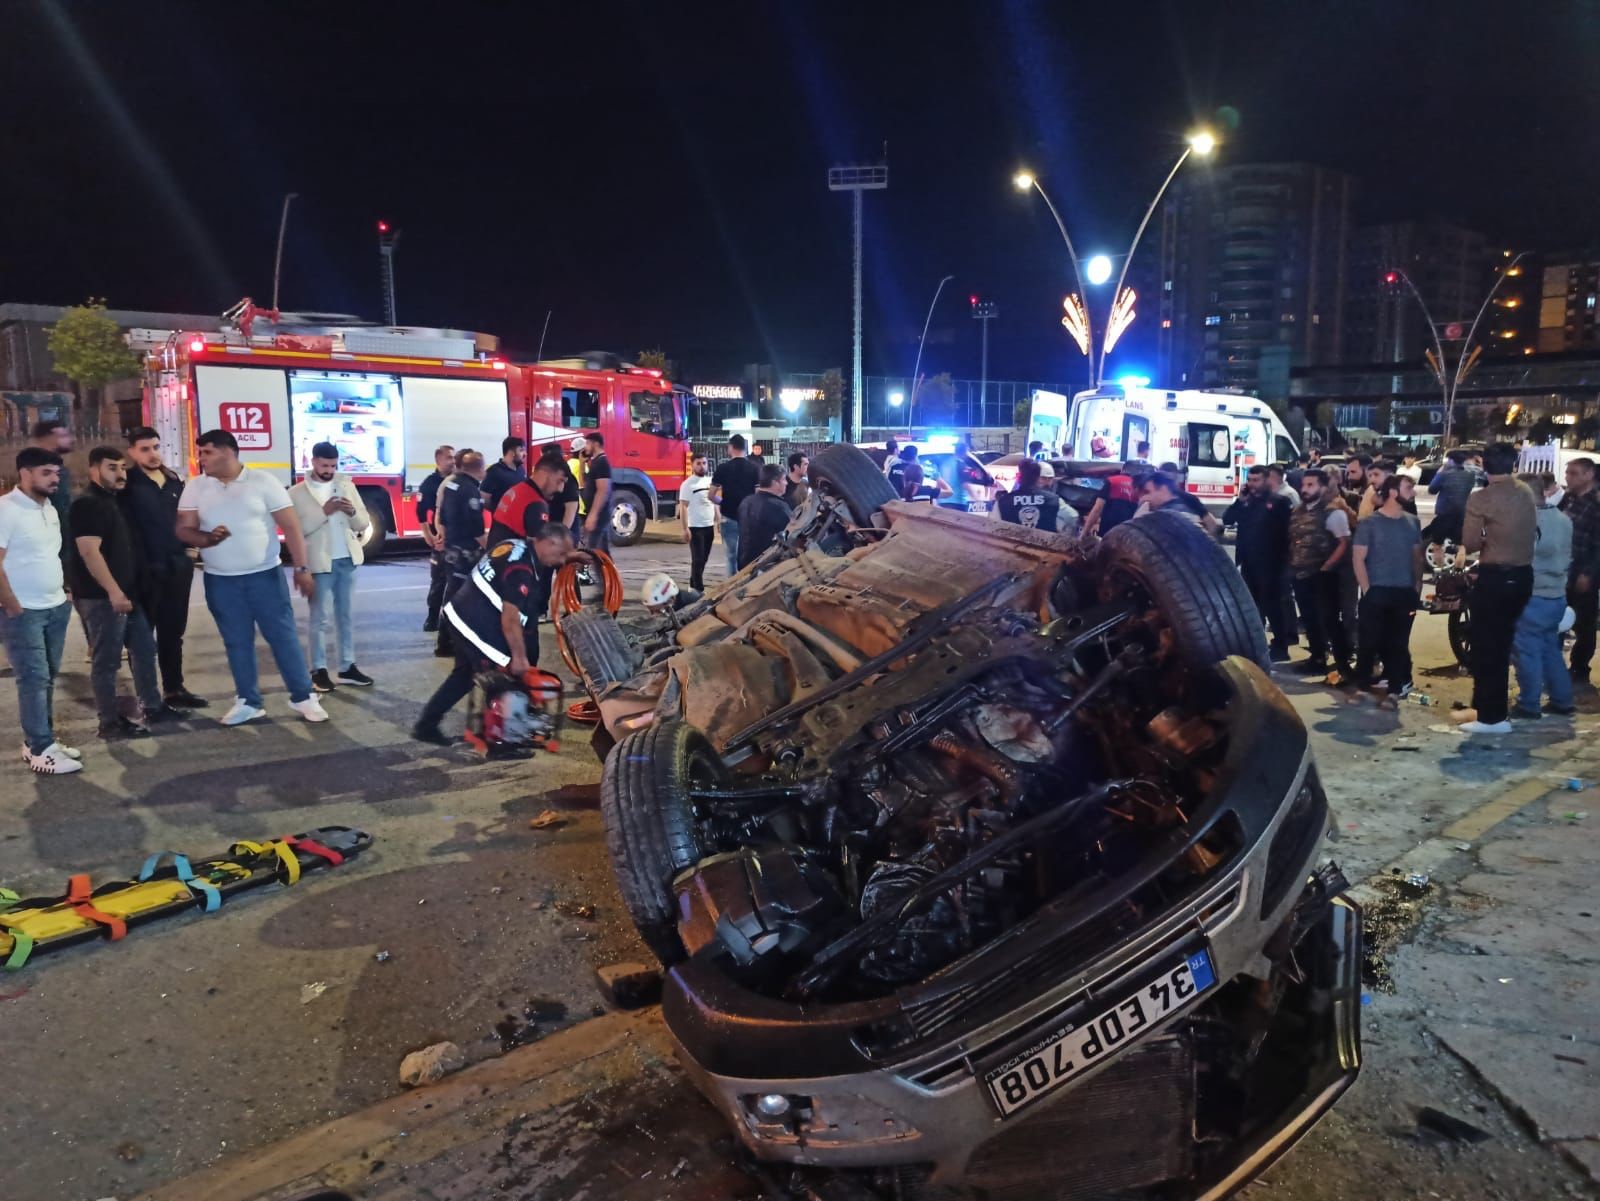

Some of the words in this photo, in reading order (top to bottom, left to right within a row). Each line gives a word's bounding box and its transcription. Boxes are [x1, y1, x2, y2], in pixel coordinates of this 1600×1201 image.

[226, 408, 263, 429] 112
[1191, 956, 1206, 970] TR
[1149, 964, 1196, 1012] 34
[1081, 997, 1147, 1059] EDP
[1000, 1044, 1075, 1106] 708
